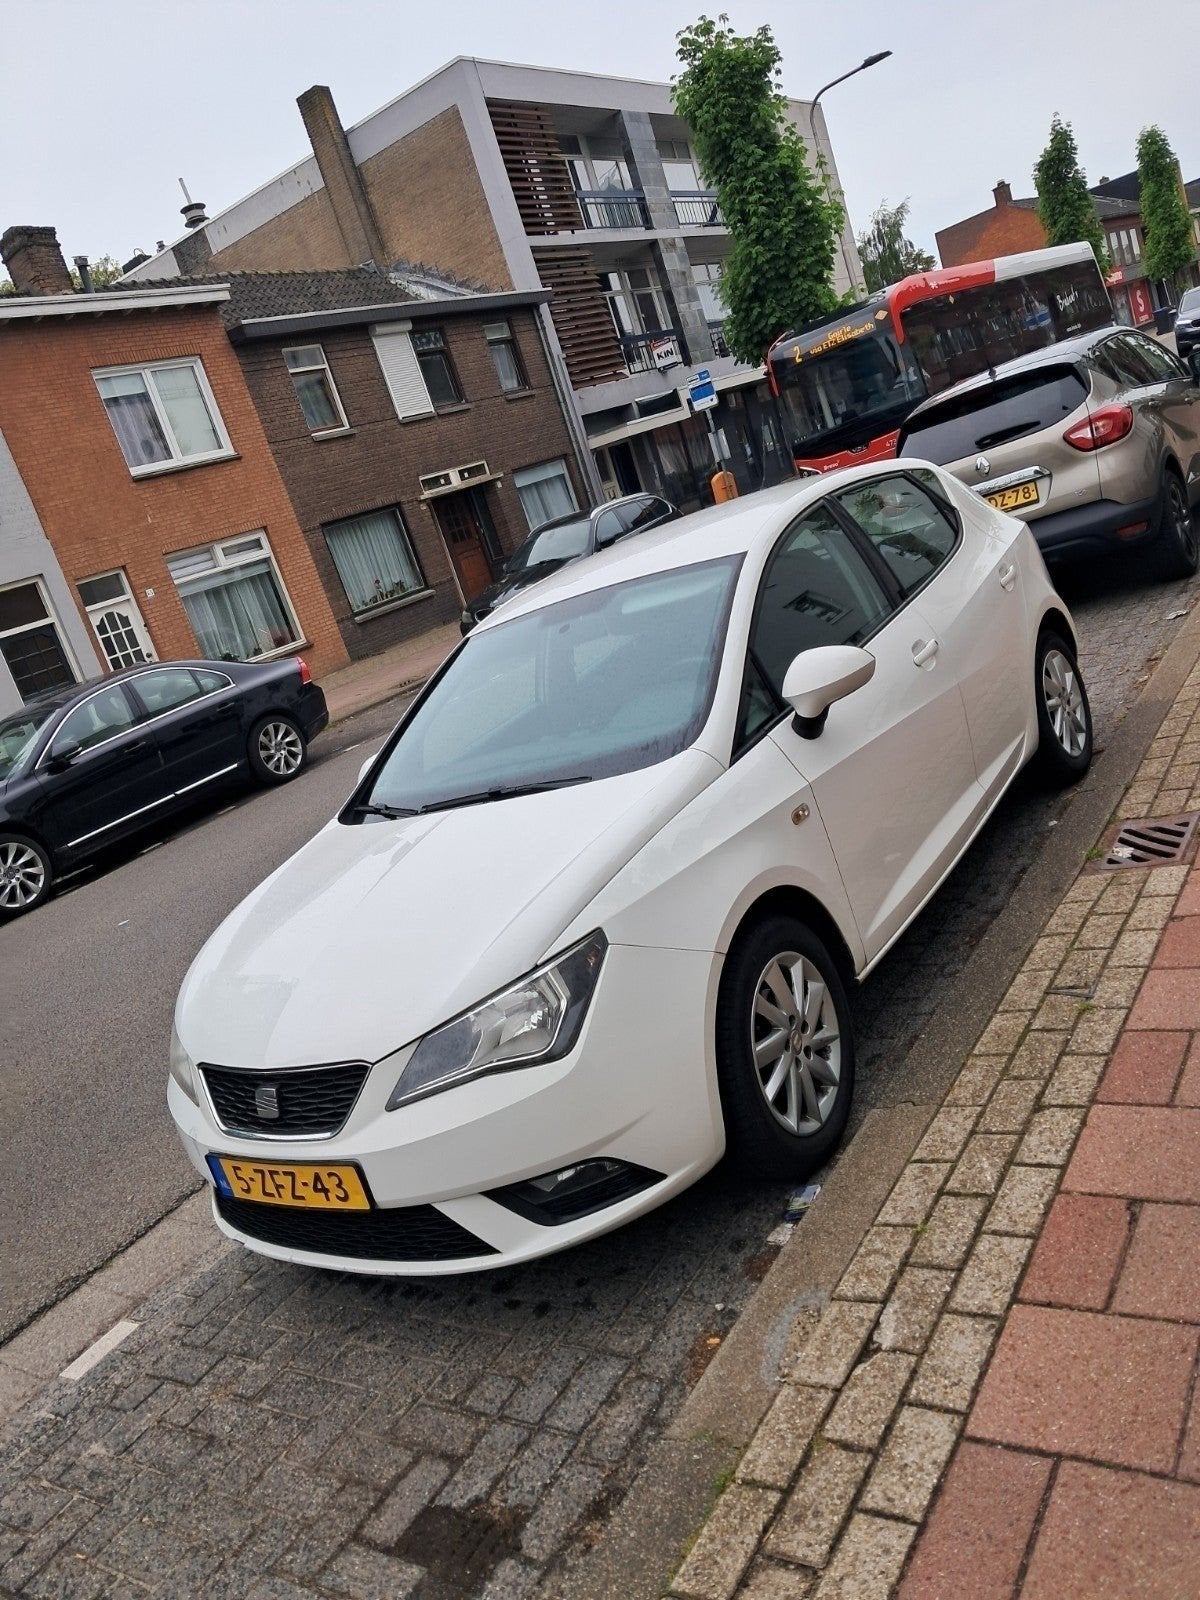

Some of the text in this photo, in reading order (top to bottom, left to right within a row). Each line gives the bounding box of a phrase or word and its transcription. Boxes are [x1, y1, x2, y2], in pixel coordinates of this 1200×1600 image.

[1136, 290, 1145, 312] S
[809, 322, 875, 355] via ETZ Elisabeth
[827, 325, 852, 339] Goirle
[656, 348, 674, 360] KIN
[793, 345, 803, 363] 2
[232, 1165, 350, 1202] 5-ZFZ-43
